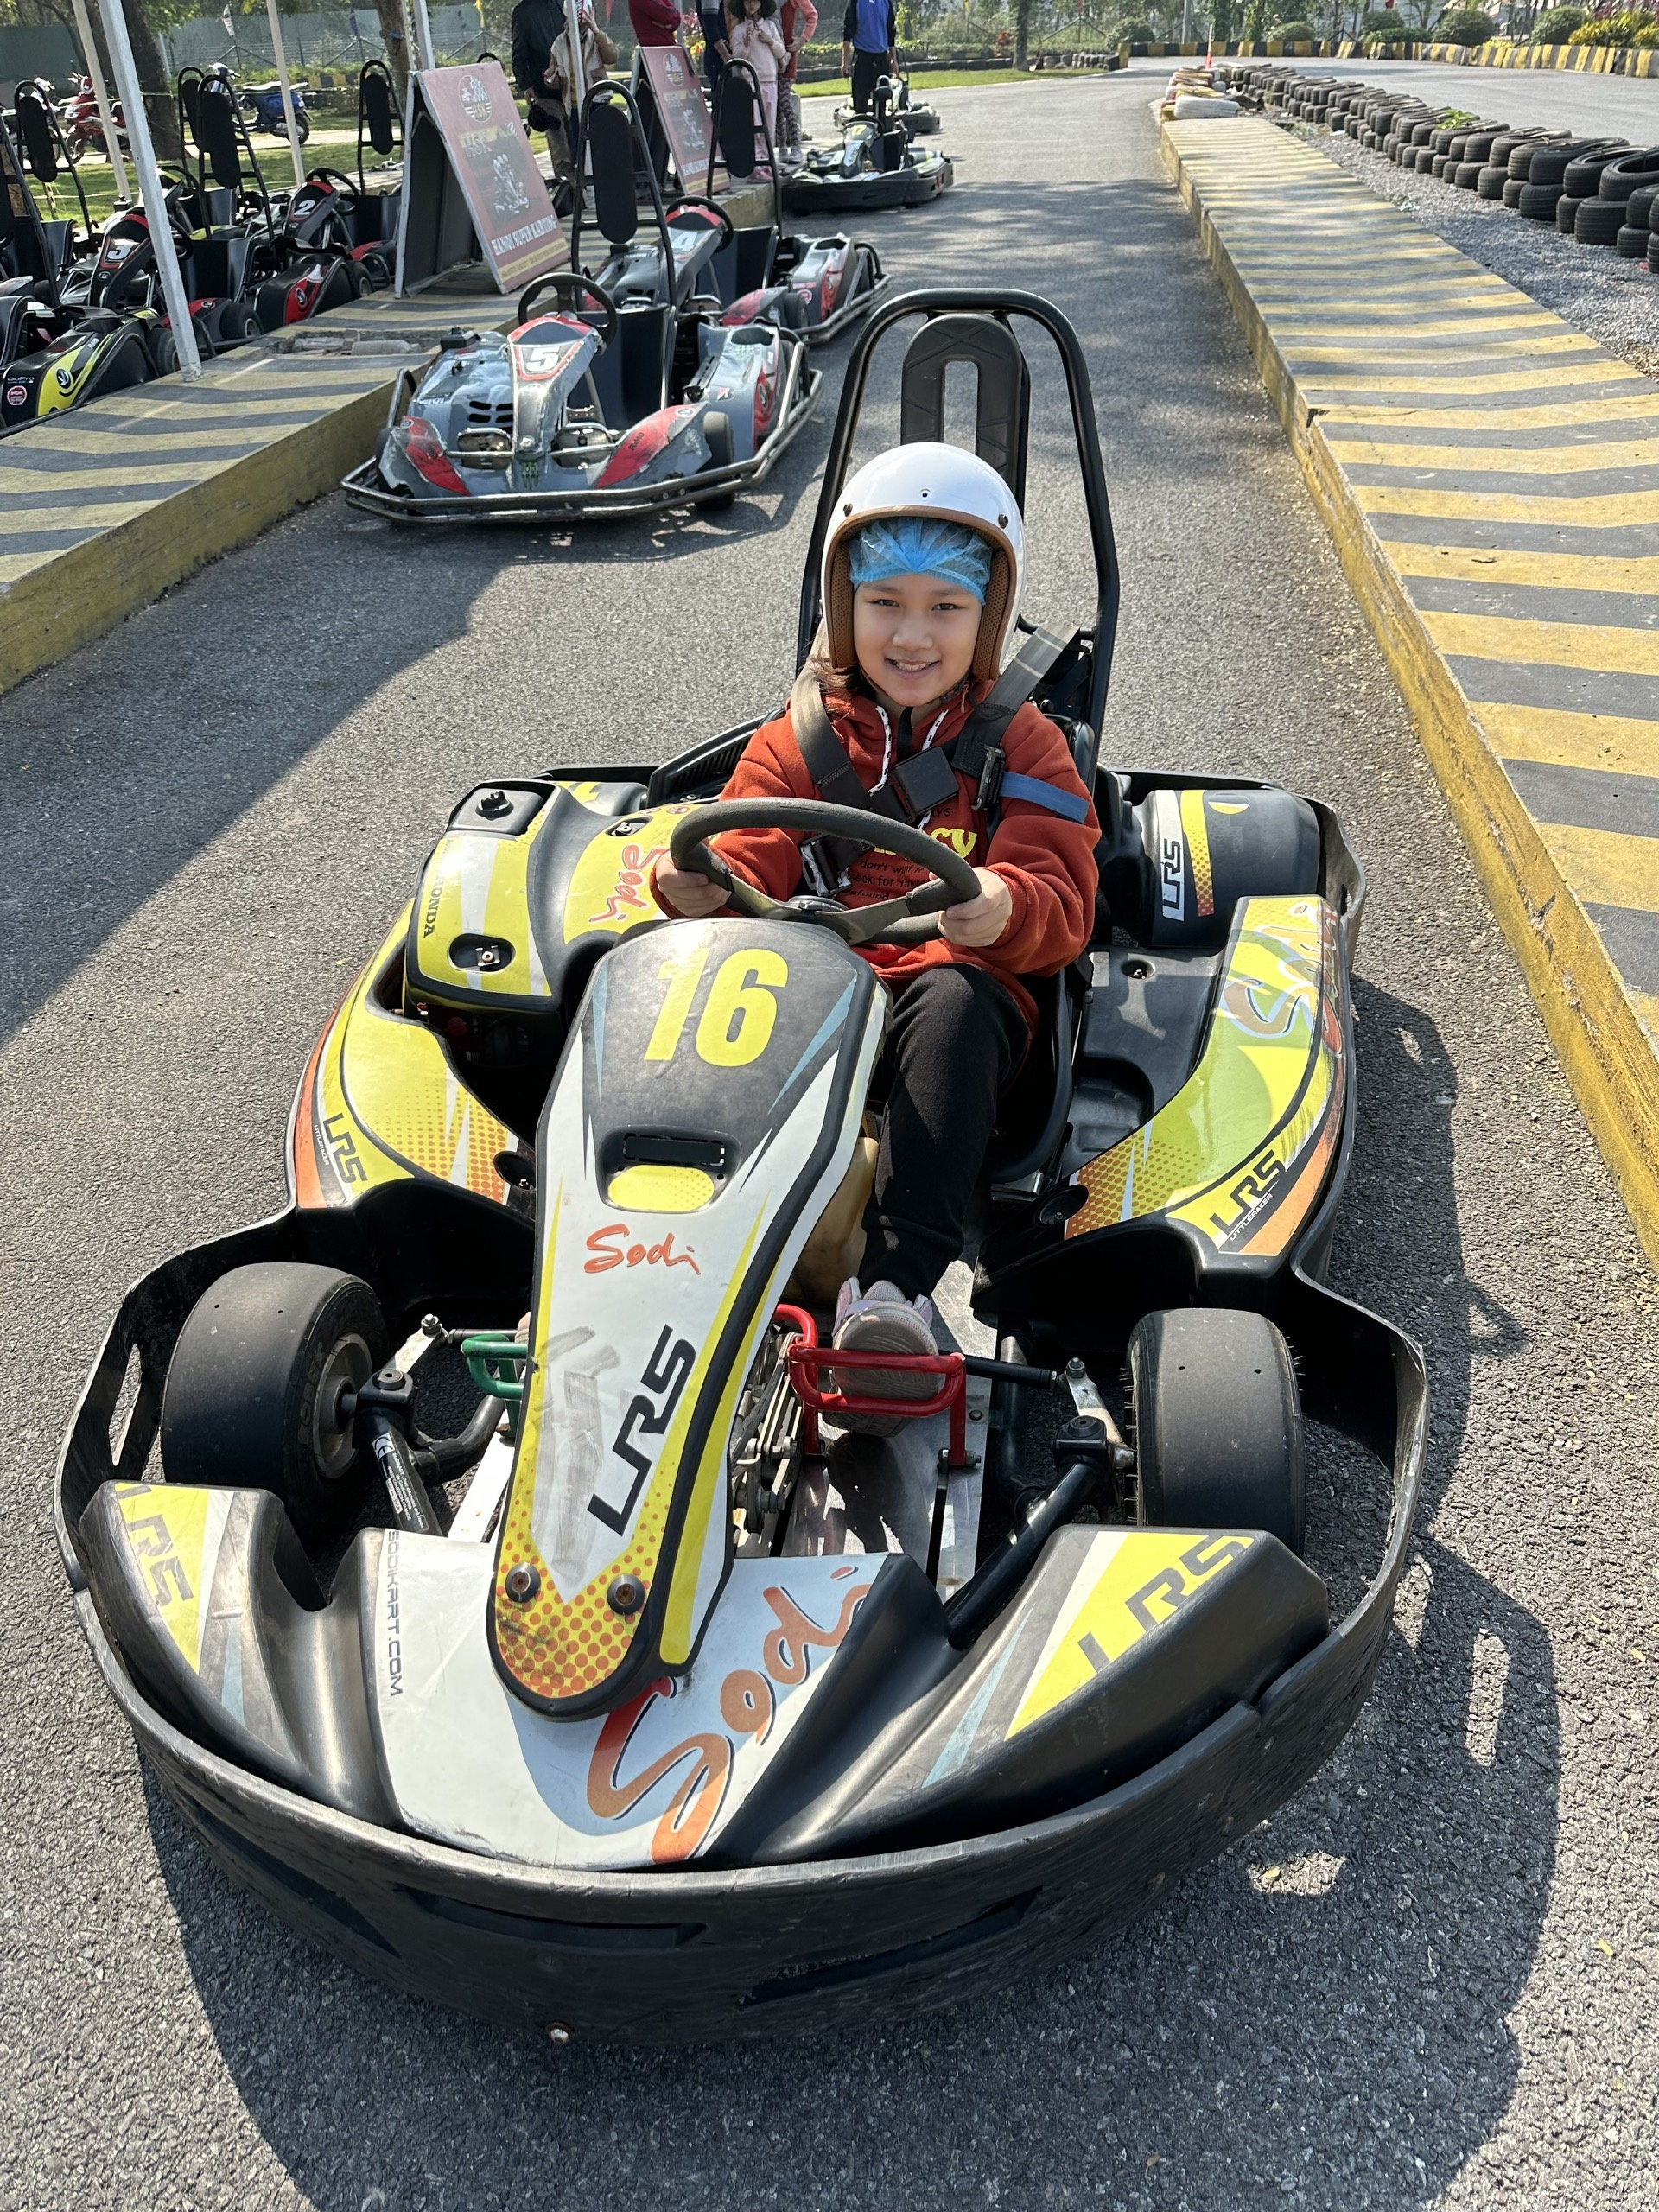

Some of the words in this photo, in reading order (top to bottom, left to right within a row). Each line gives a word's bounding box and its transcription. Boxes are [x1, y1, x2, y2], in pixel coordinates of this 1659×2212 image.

[294, 200, 315, 215] 2
[671, 232, 698, 252] 4
[525, 346, 560, 372] 5
[423, 875, 444, 938] HONDA
[588, 843, 671, 924] Sodi
[849, 874, 873, 885] seek
[877, 875, 895, 887] for
[1162, 838, 1181, 911] LRS
[644, 948, 789, 1067] 16
[323, 1112, 369, 1184] LRS
[1209, 1149, 1286, 1236] LRS
[583, 1223, 702, 1275] Sodi
[587, 1324, 696, 1537] LRS
[387, 1530, 404, 1697] SODIKART.COM
[586, 1566, 873, 1865] Sodi
